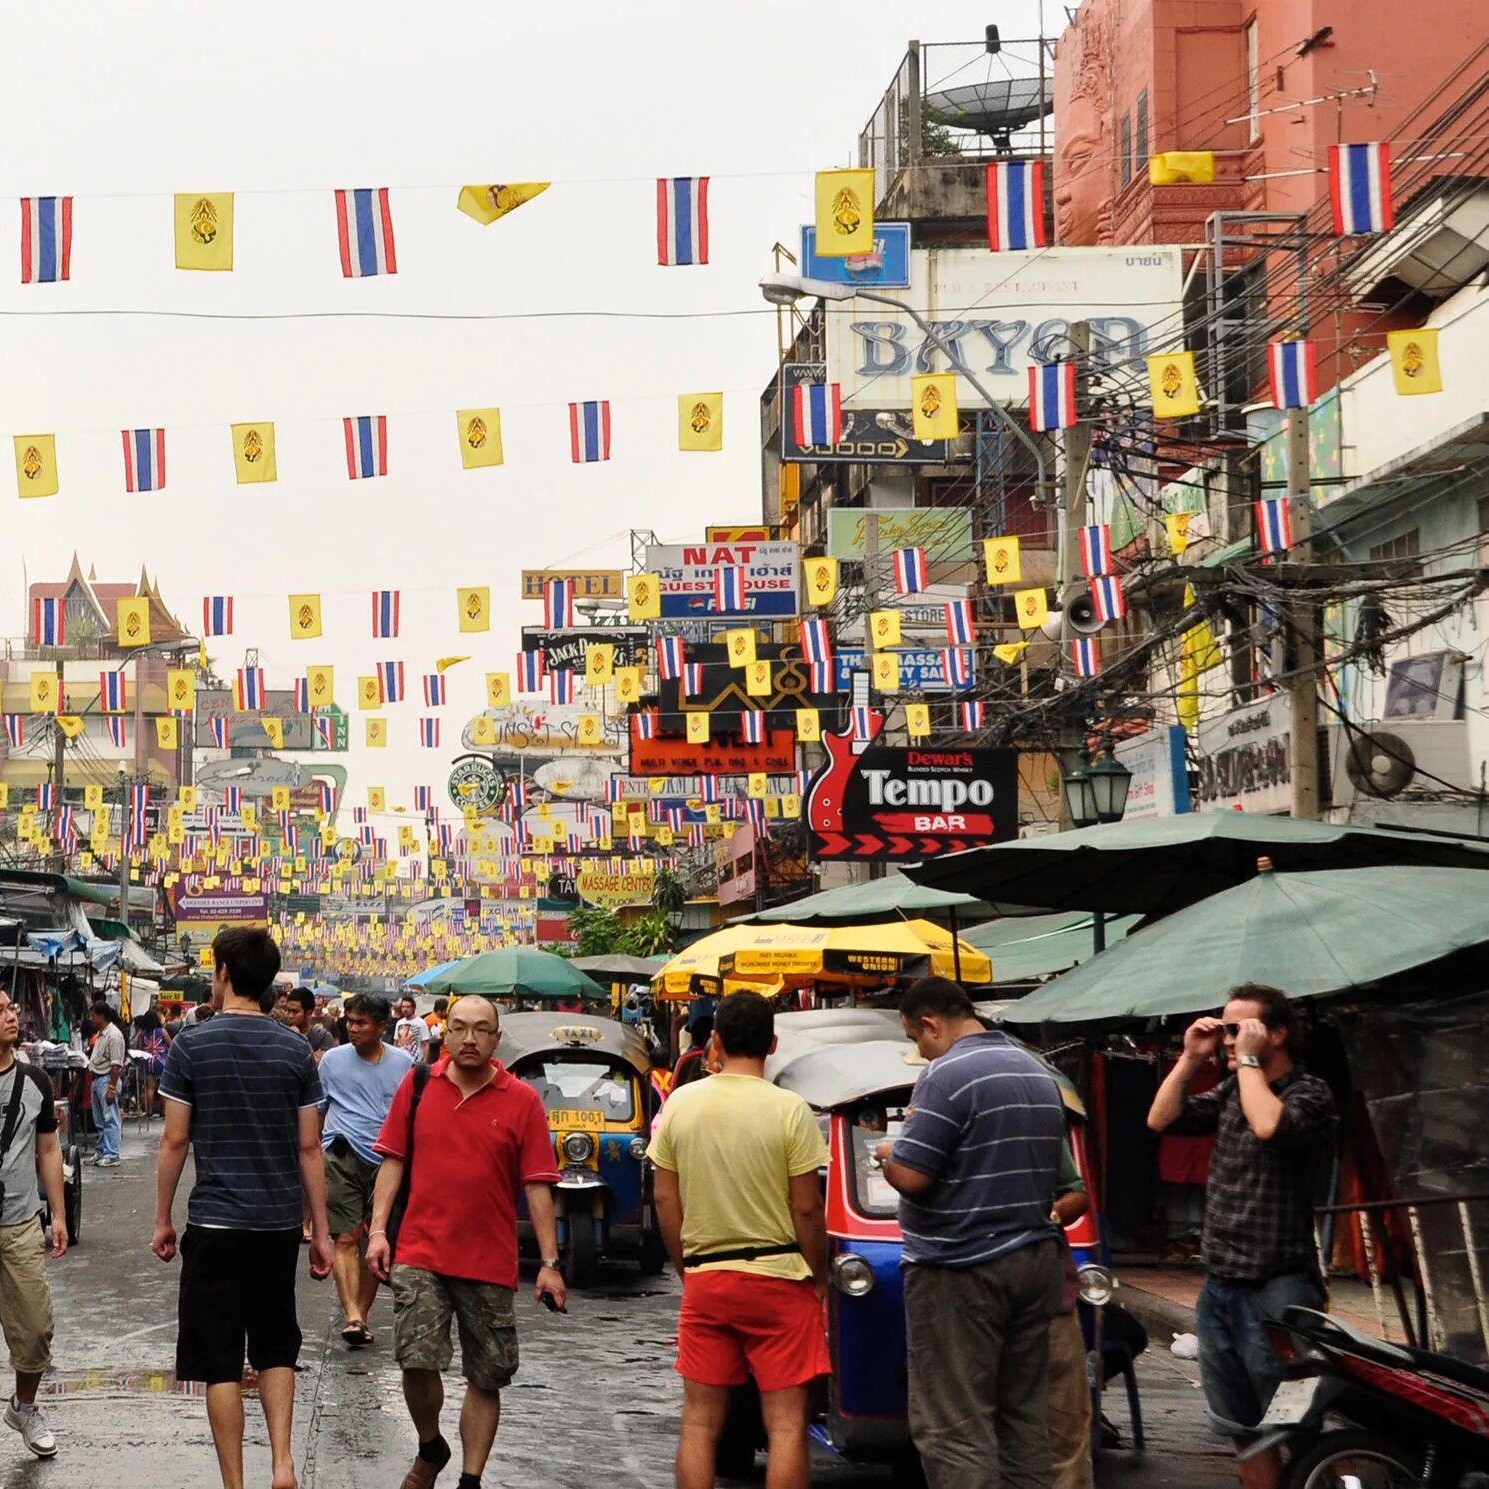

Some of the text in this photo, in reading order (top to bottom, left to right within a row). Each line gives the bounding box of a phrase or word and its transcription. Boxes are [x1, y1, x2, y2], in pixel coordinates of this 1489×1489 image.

[683, 546, 757, 566] NAT
[526, 575, 618, 594] HTEL
[660, 579, 791, 592] GUEST OUSE
[549, 642, 579, 666] JACK
[498, 720, 554, 749] UNSET
[451, 764, 496, 787] STARBUCKS
[860, 769, 994, 813] Tempo
[455, 796, 491, 810] COEE
[914, 815, 967, 832] BAR
[581, 875, 652, 892] MASSAGE CENTER
[847, 955, 896, 965] WESTERN
[862, 963, 896, 971] UNION
[564, 1028, 595, 1039] TAXI
[574, 1111, 602, 1123] 1001
